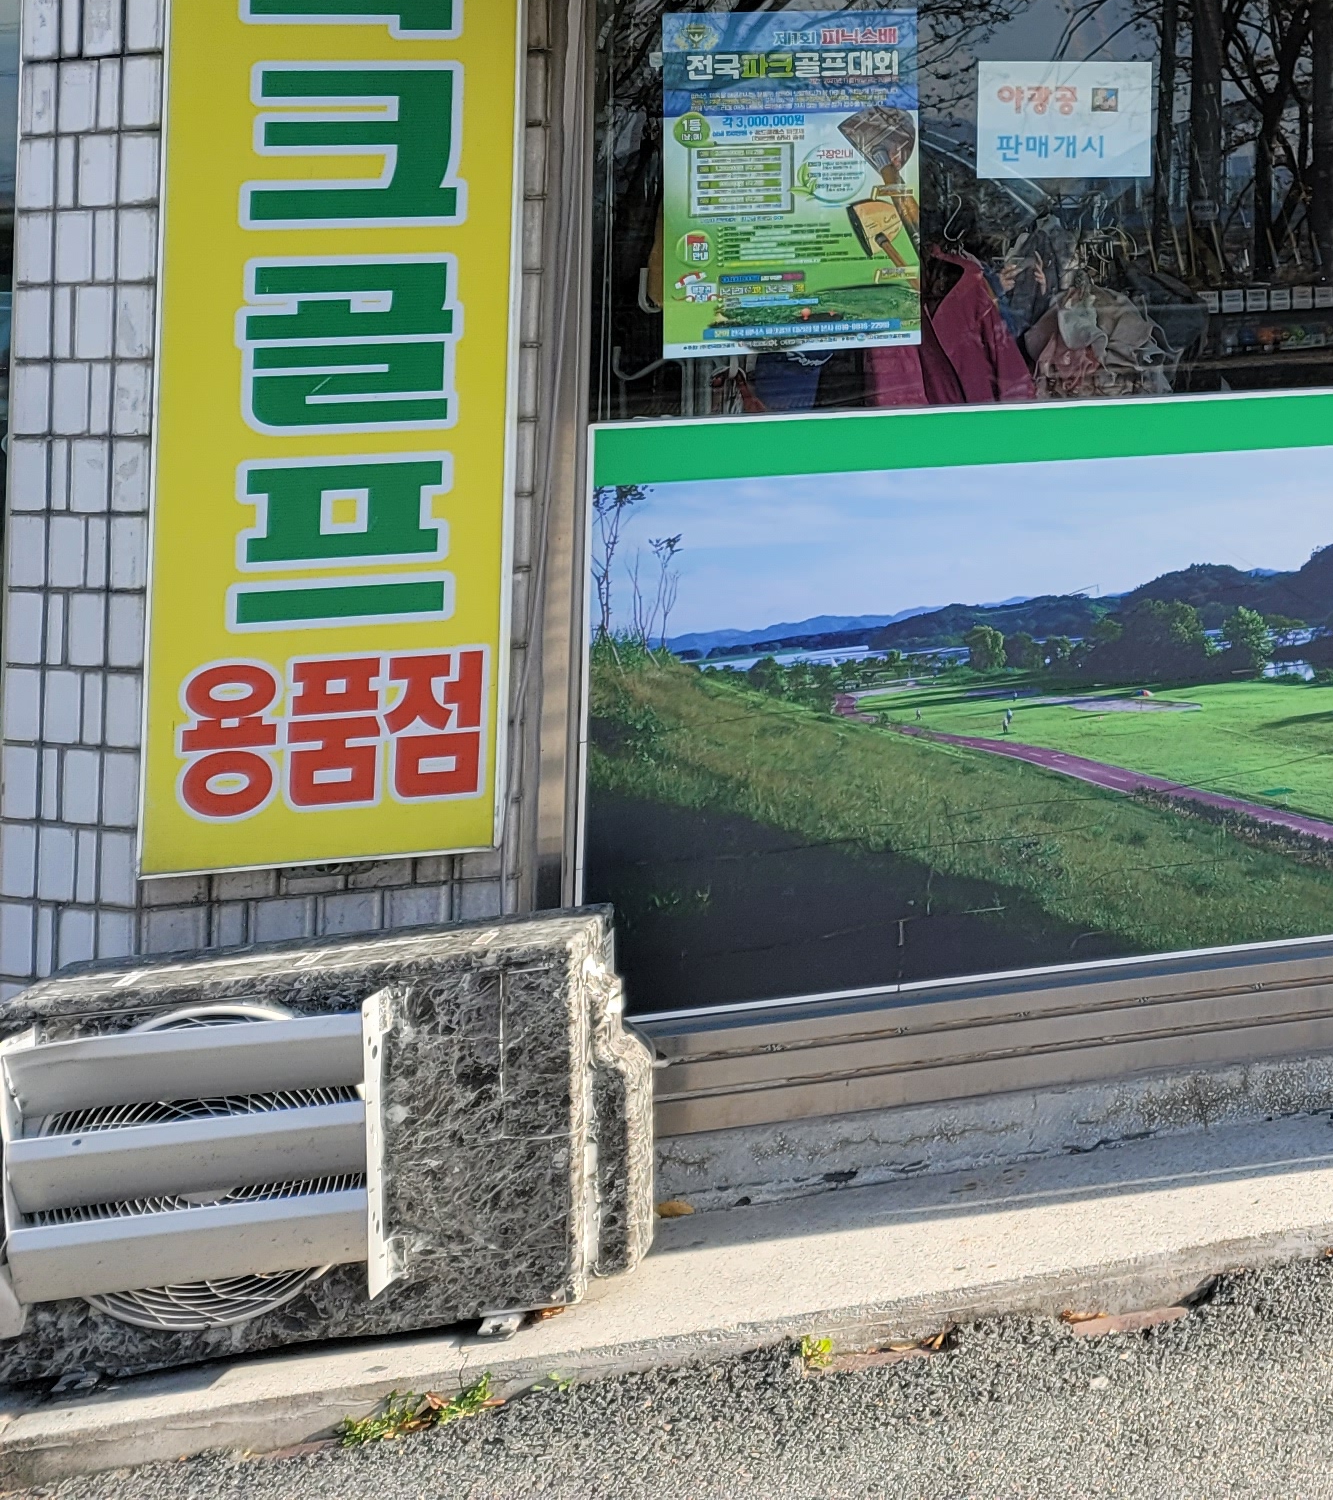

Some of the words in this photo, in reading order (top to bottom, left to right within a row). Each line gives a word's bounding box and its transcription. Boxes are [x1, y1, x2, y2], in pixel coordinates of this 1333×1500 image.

[685, 50, 899, 81] 전국파크골프대회
[997, 85, 1078, 115] 야광공
[996, 134, 1104, 162] 판매개시
[175, 647, 490, 824] 용품점
